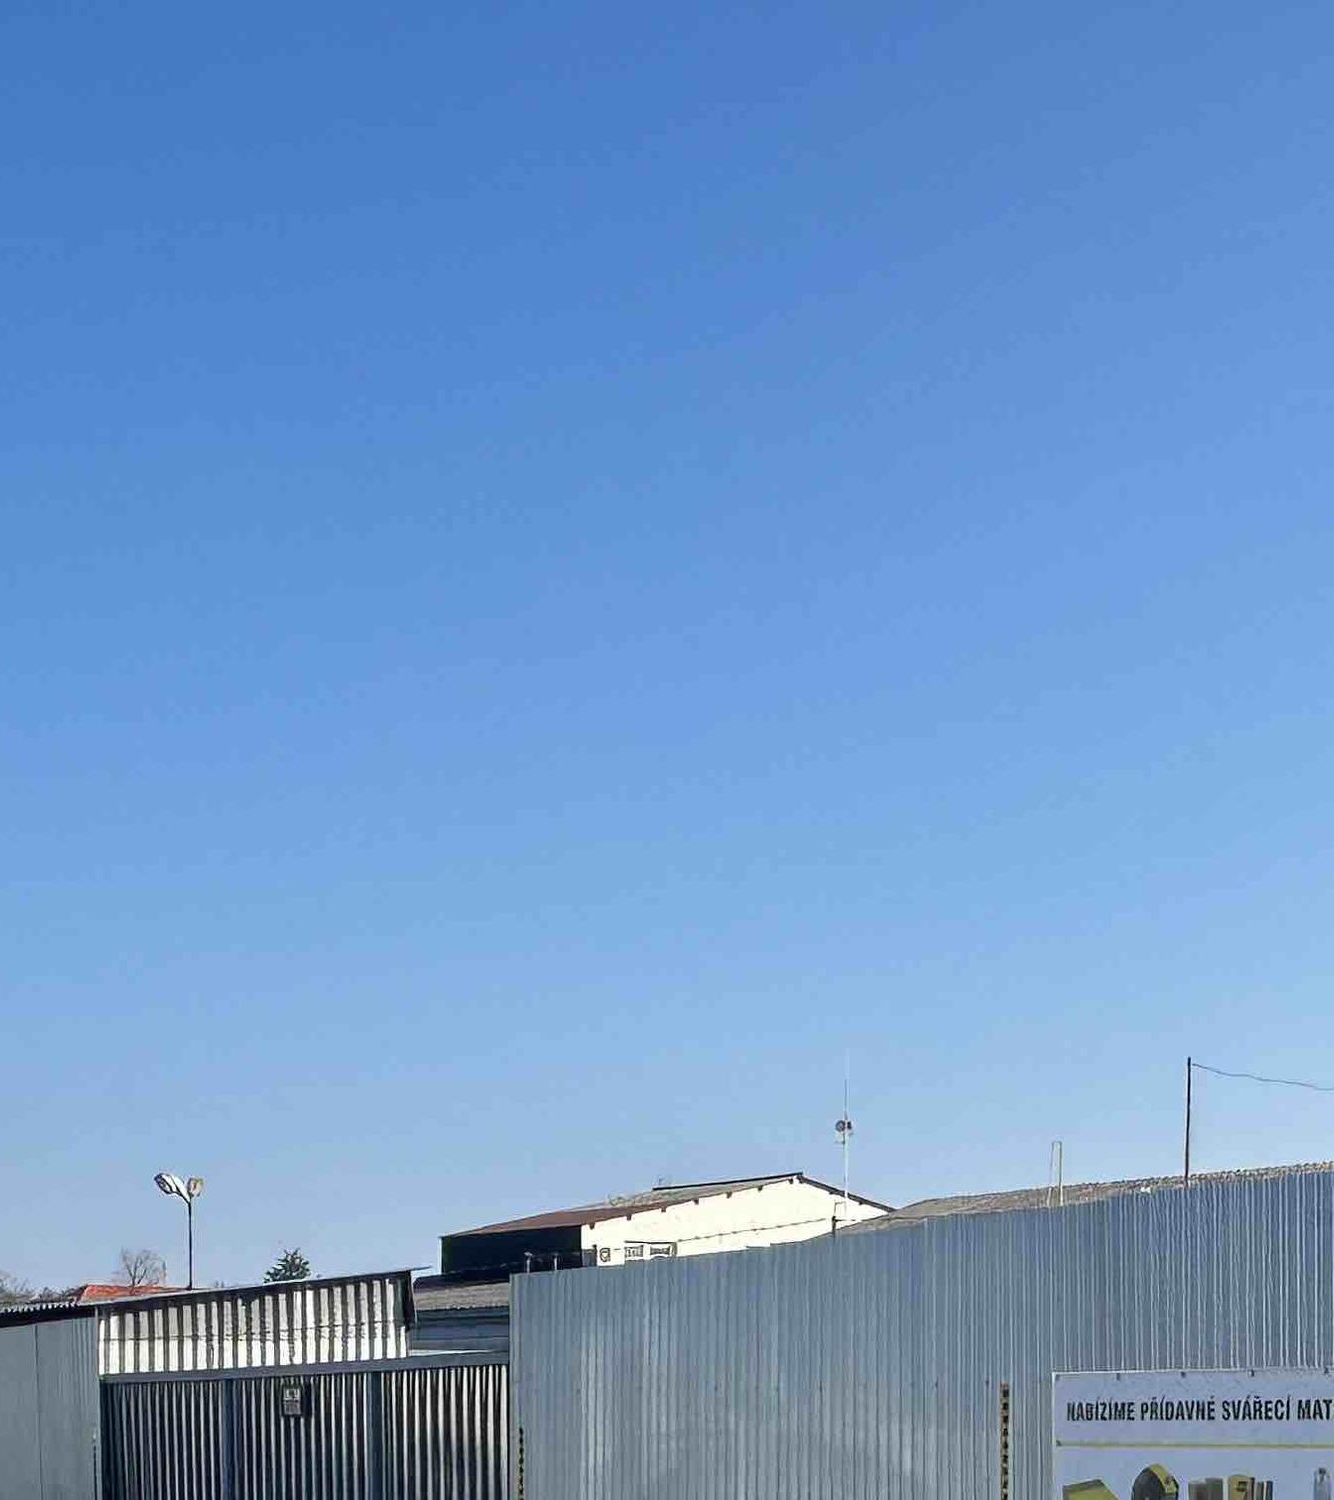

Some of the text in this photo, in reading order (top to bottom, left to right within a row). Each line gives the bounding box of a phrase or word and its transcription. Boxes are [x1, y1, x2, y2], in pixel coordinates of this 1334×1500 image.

[1067, 1396, 1135, 1421] NABÍZÍME
[1140, 1394, 1216, 1421] PŘÍDAVNÉ
[1221, 1394, 1291, 1421] SVÁŘECÍ
